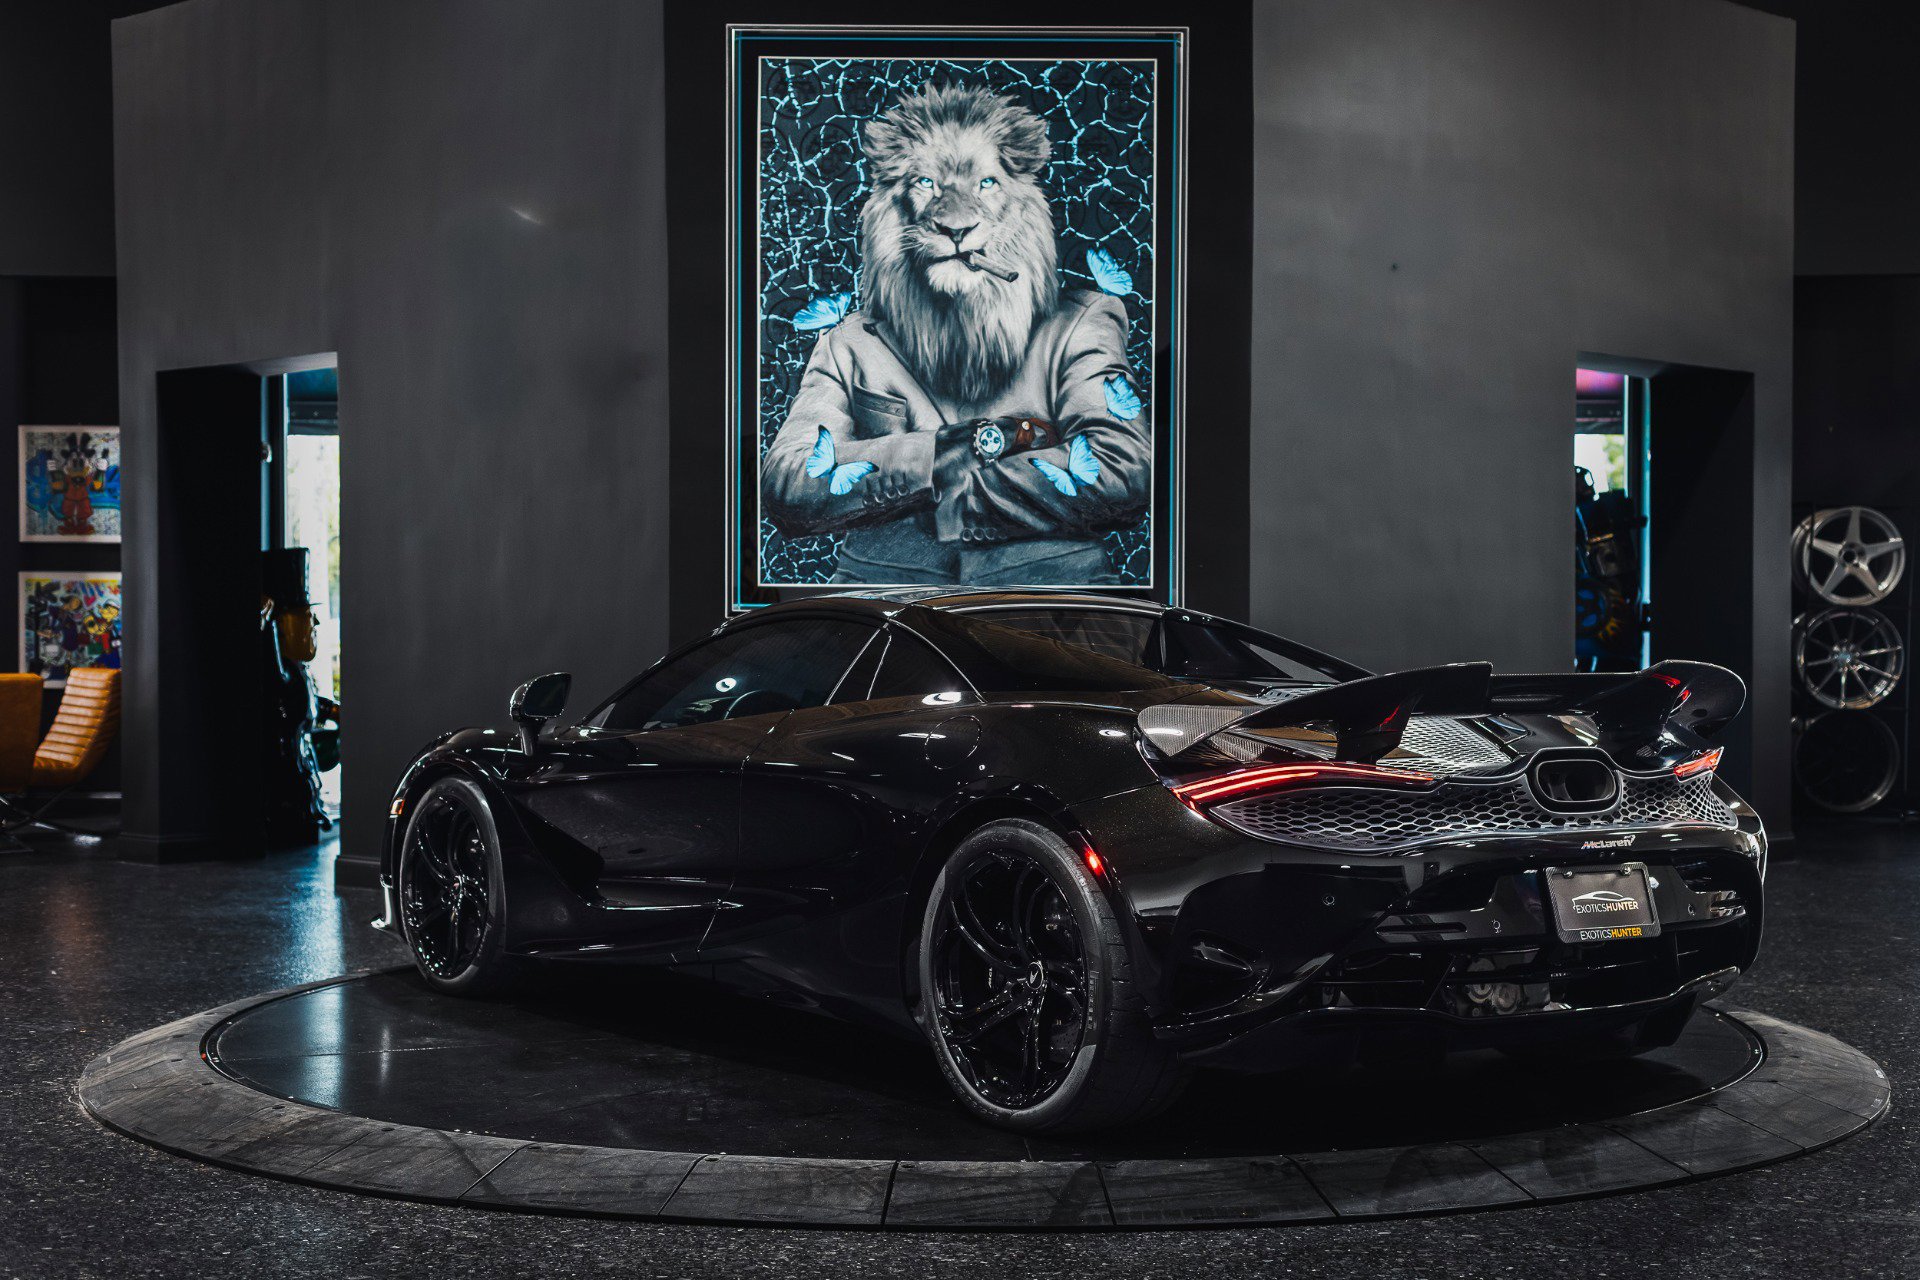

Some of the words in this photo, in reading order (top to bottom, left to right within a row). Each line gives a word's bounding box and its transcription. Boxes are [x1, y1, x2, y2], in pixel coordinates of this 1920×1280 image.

[1581, 836, 1634, 850] McLaren
[1576, 901, 1639, 914] EXOTICSHUNTER
[1580, 927, 1643, 940] EXOTICSHUNTER
